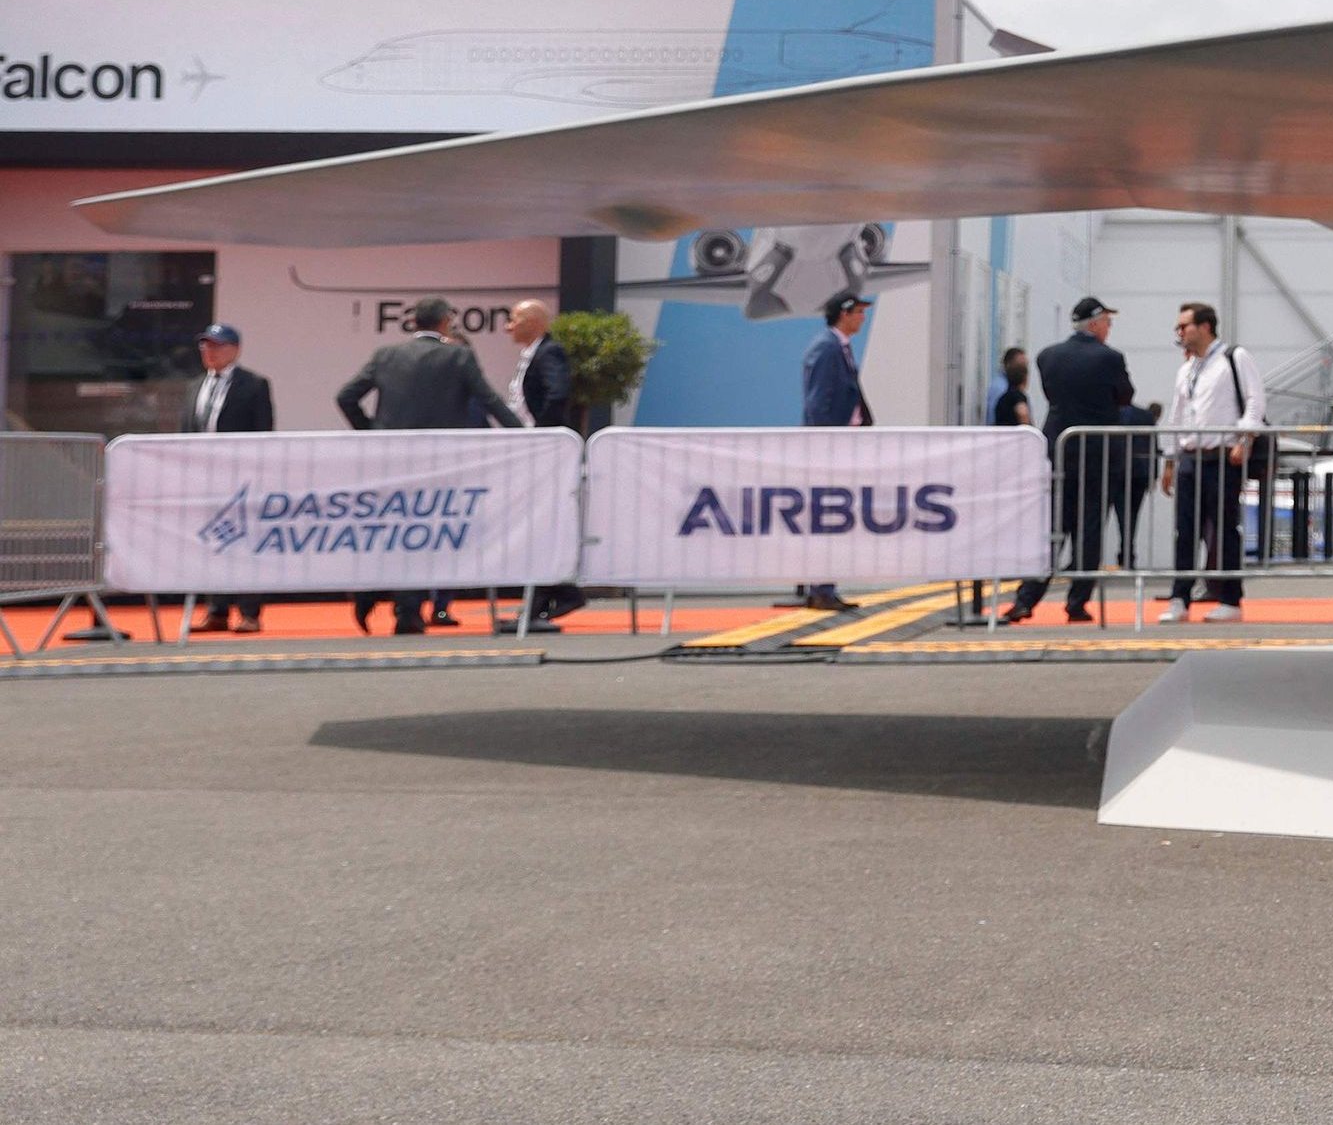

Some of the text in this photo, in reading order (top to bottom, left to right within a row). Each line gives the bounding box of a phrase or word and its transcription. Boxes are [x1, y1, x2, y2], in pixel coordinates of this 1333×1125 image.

[0, 54, 162, 100] alcon
[257, 488, 488, 520] DASSAULT
[677, 484, 957, 536] AIRBUS
[254, 523, 468, 554] AVIATION
